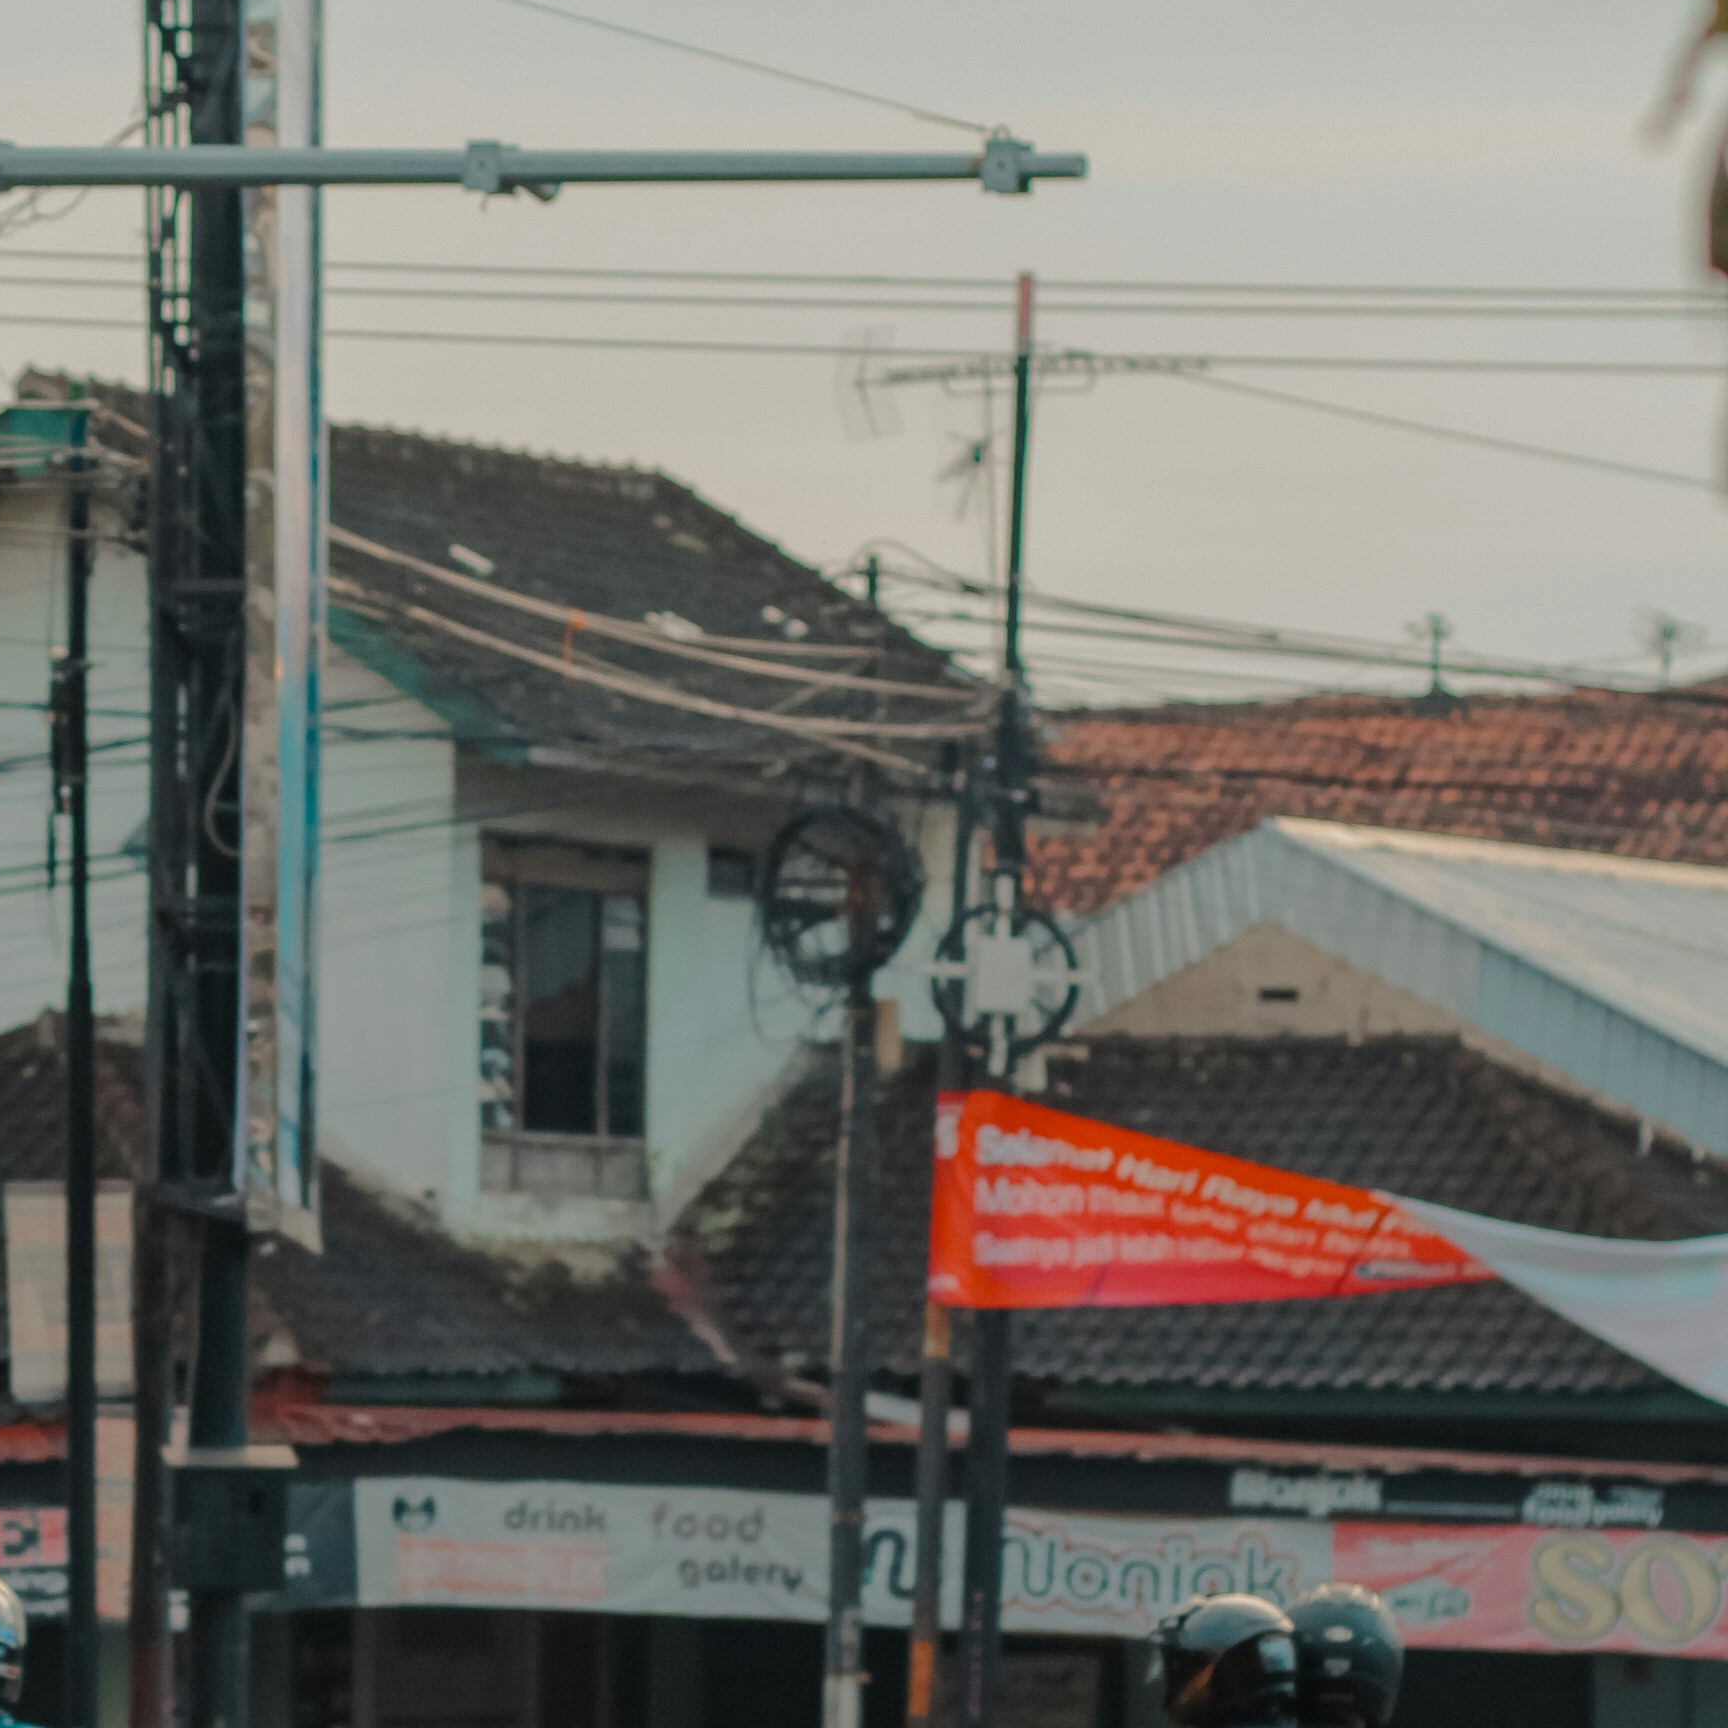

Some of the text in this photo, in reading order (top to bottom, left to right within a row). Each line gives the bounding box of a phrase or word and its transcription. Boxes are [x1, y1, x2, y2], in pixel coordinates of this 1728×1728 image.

[503, 1500, 766, 1546] drink food
[679, 1554, 803, 1594] galery
